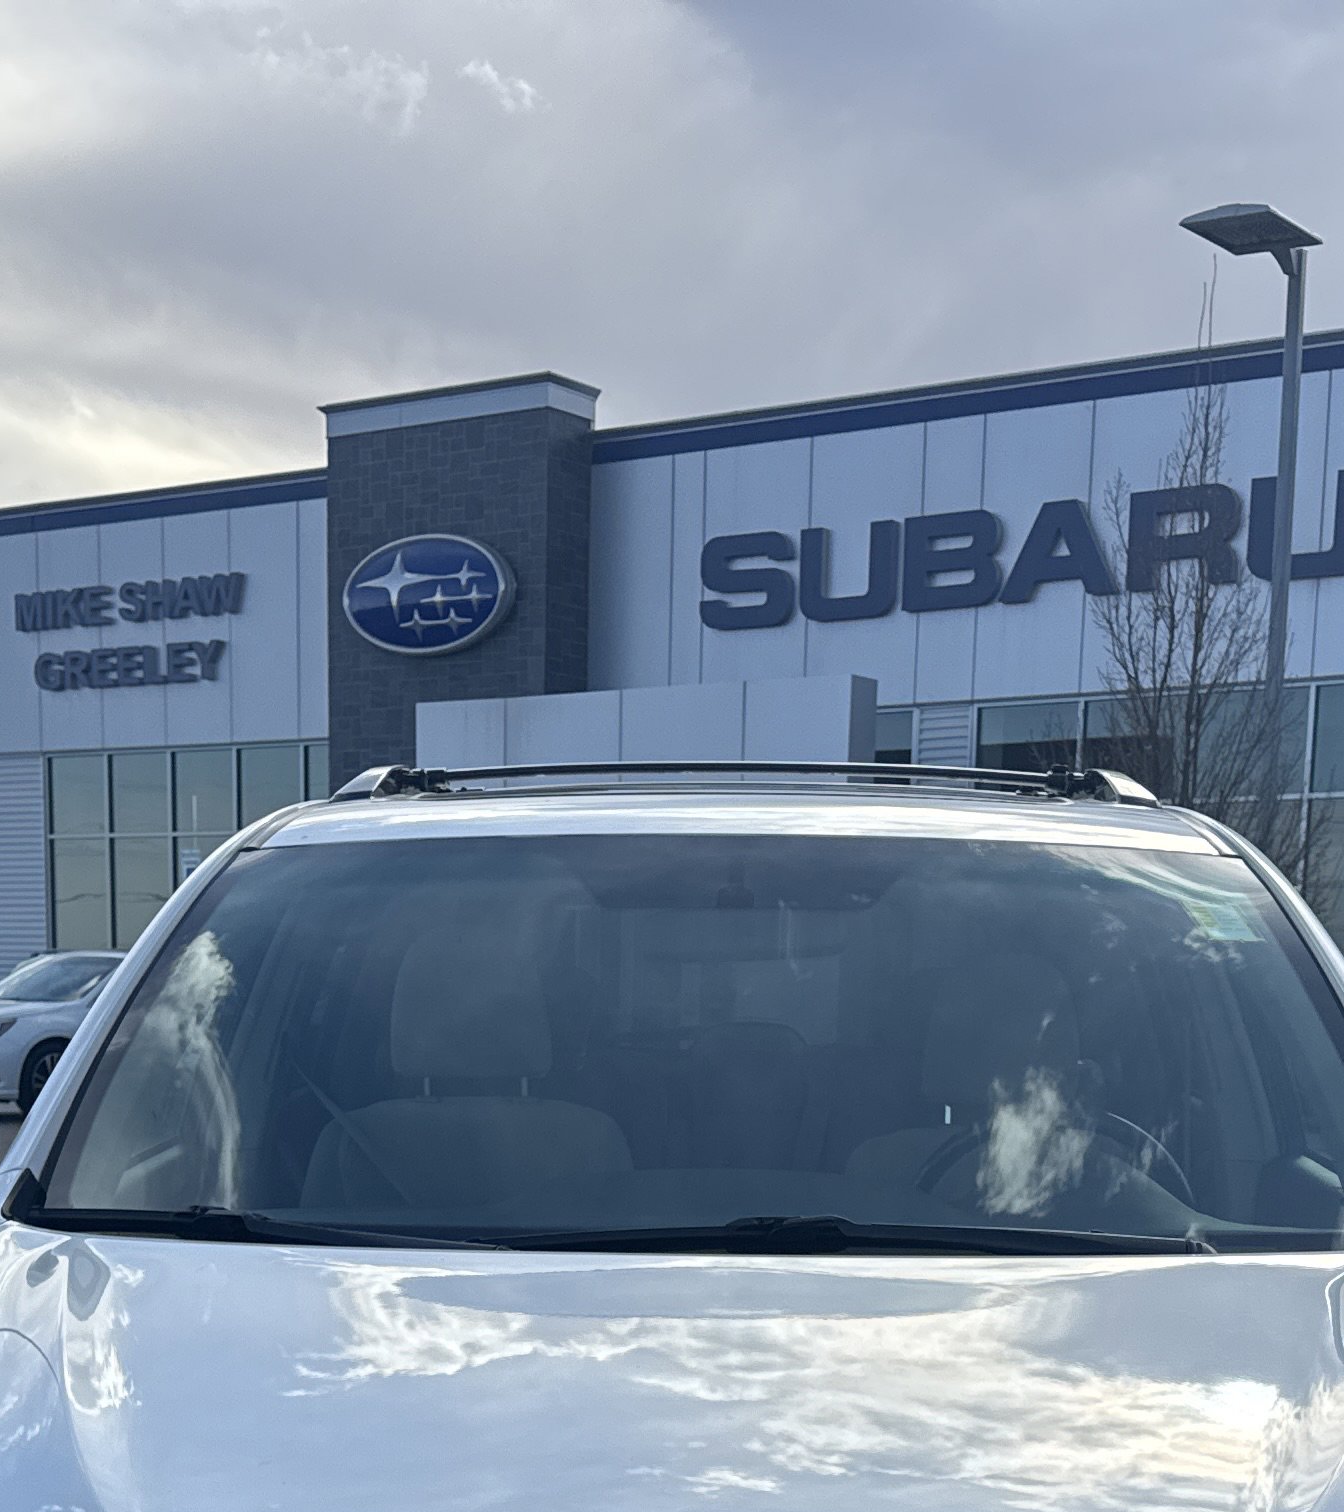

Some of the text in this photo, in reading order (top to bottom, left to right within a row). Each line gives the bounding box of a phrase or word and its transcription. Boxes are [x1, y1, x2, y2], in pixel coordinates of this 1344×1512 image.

[14, 572, 247, 632] MIKE SHAW
[34, 639, 227, 692] GREELEY
